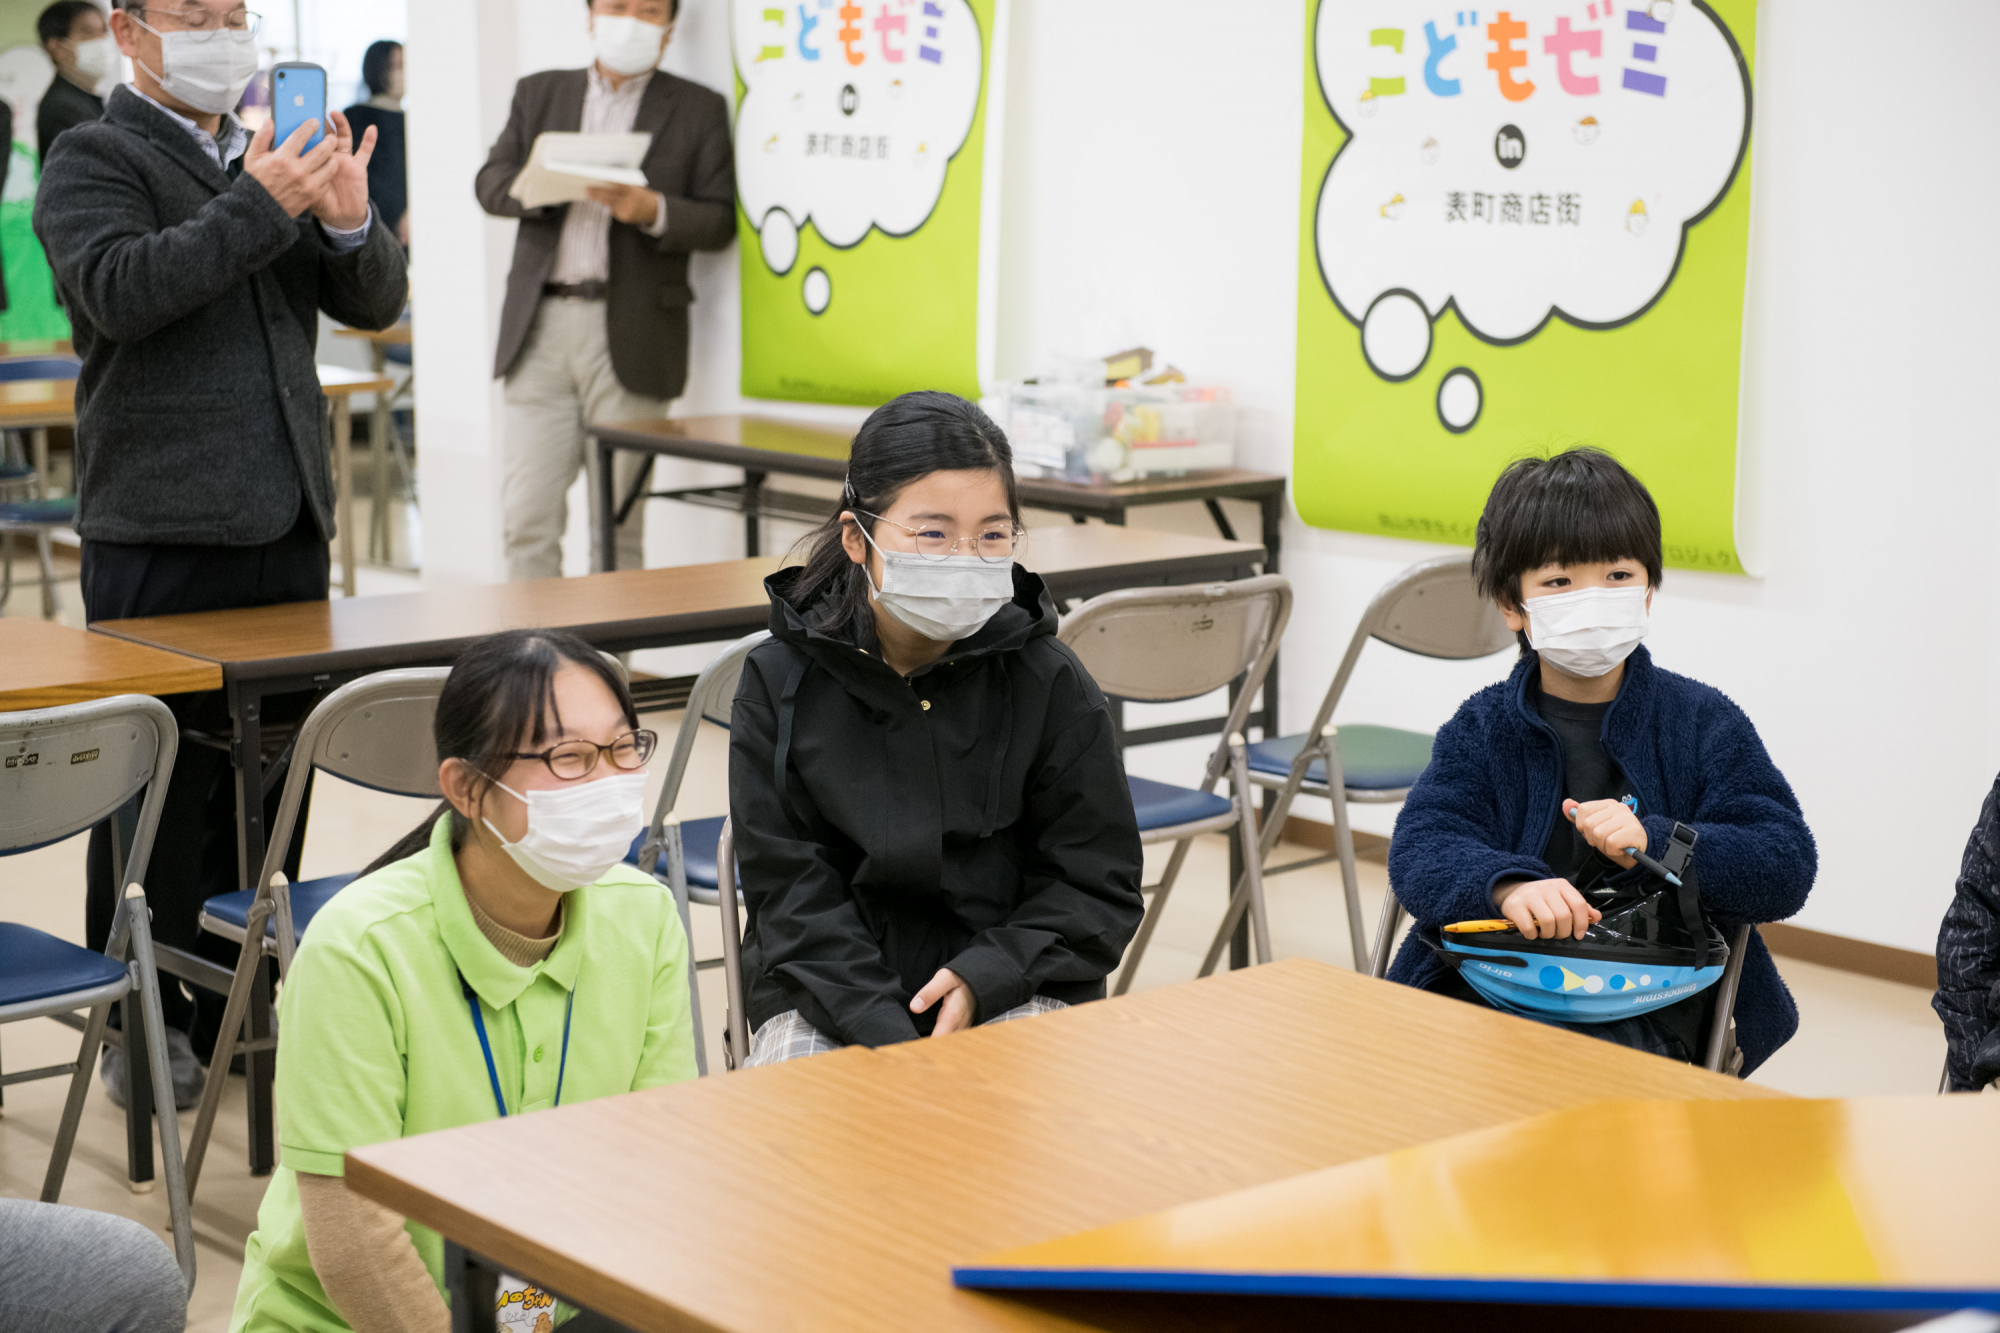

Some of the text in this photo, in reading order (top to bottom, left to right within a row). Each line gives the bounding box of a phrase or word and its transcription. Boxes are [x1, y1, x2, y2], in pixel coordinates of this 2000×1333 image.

[762, 0, 944, 66] こどもゼミ
[1368, 2, 1668, 102] こどもゼミ
[1496, 131, 1525, 160] in
[1444, 189, 1583, 227] 表町商店街
[1632, 982, 1698, 1005] BRIDGESTONE
